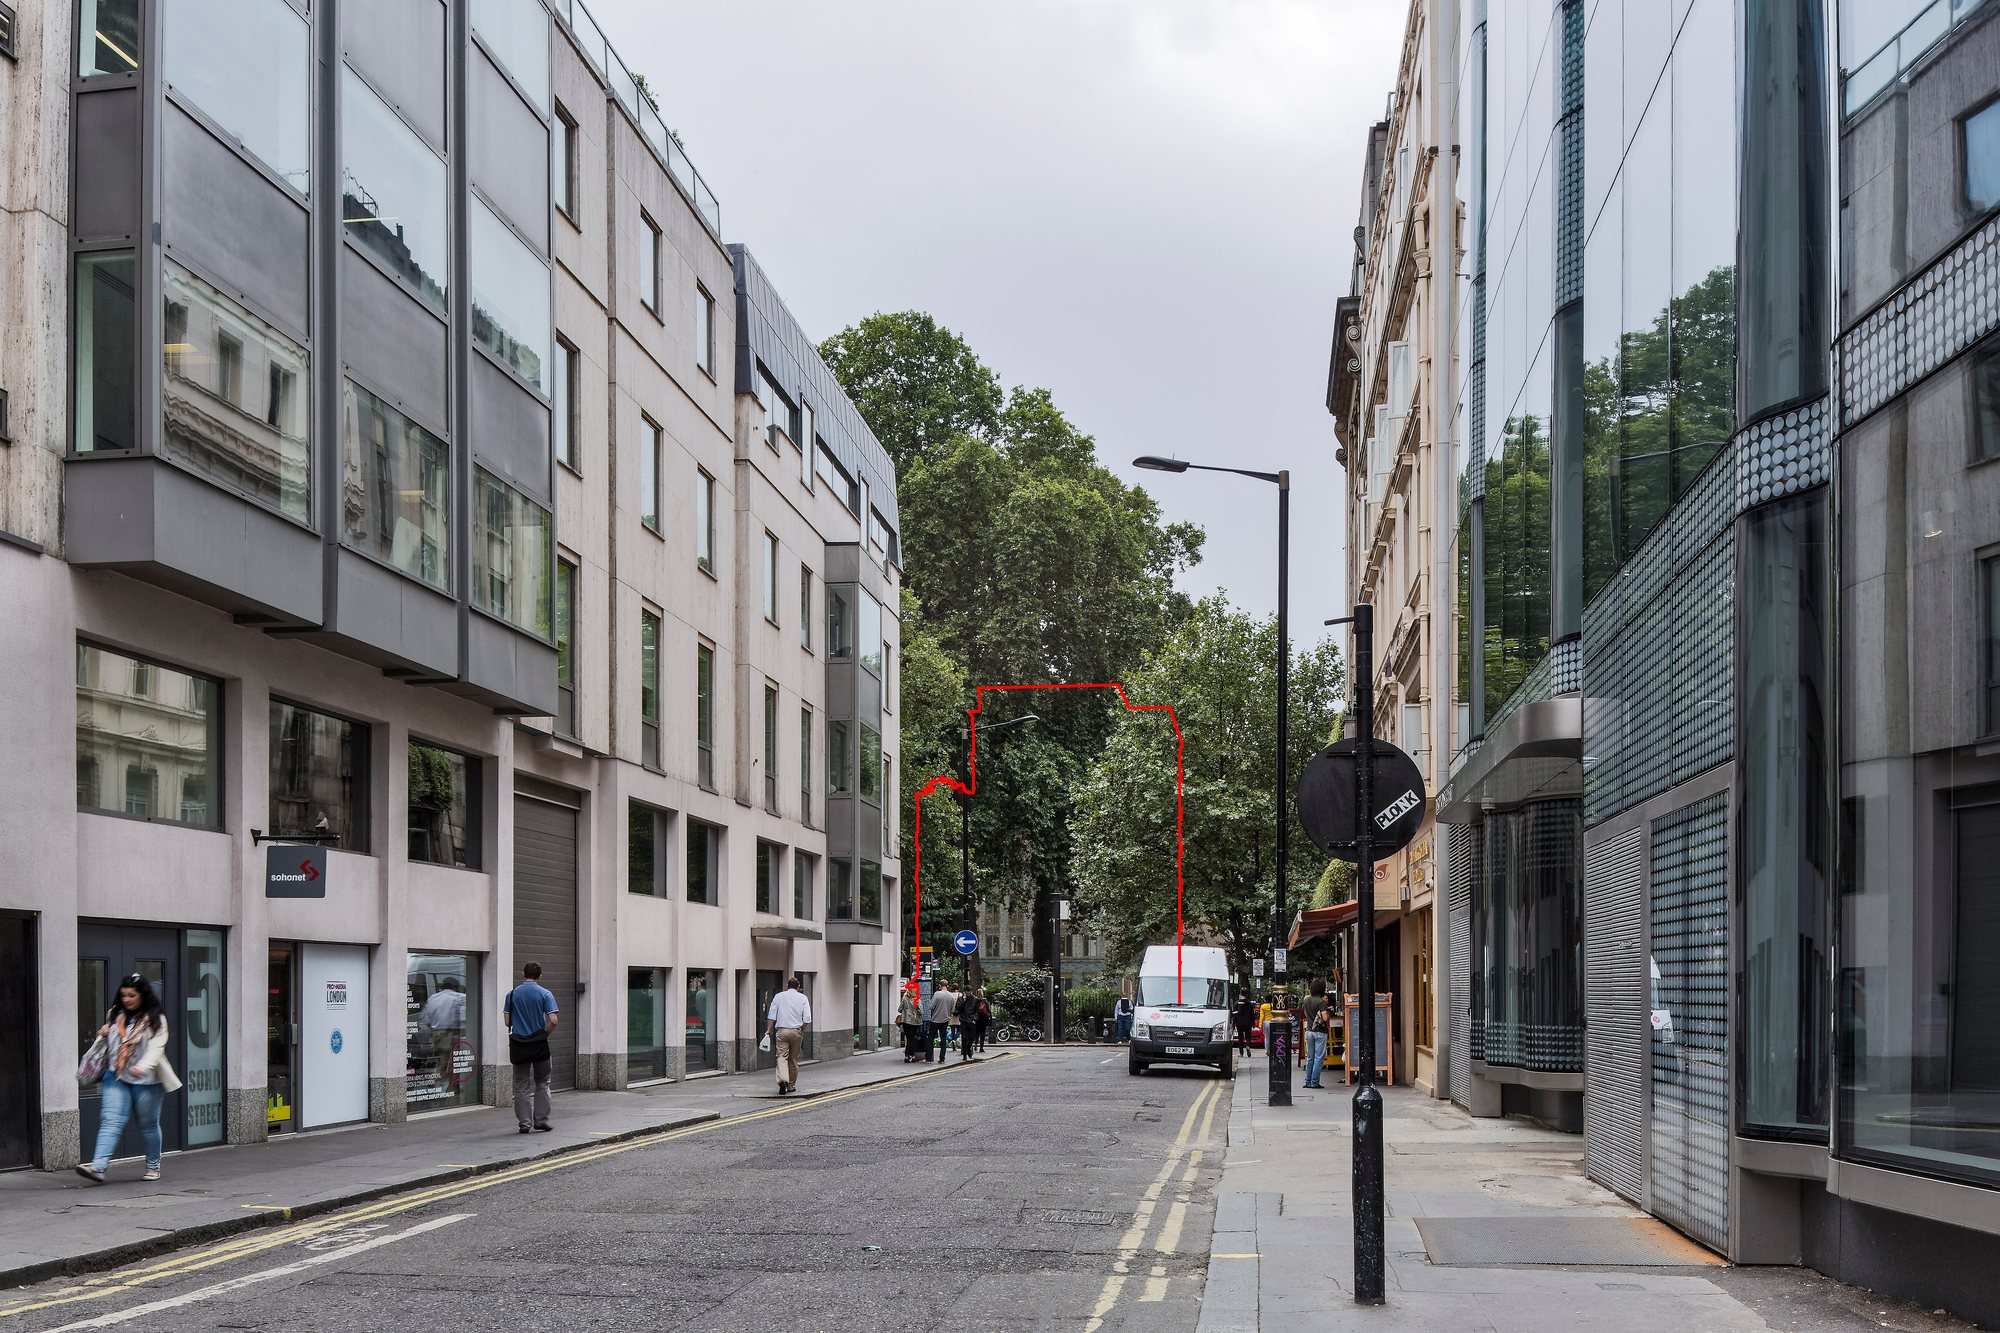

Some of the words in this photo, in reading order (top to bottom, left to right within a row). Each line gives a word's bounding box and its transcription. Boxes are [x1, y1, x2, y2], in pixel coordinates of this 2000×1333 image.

[271, 873, 306, 881] sohonet
[187, 946, 221, 1049] 5
[326, 990, 347, 1003] LONDON
[189, 1069, 221, 1092] SOHO
[188, 1102, 221, 1128] STREET
